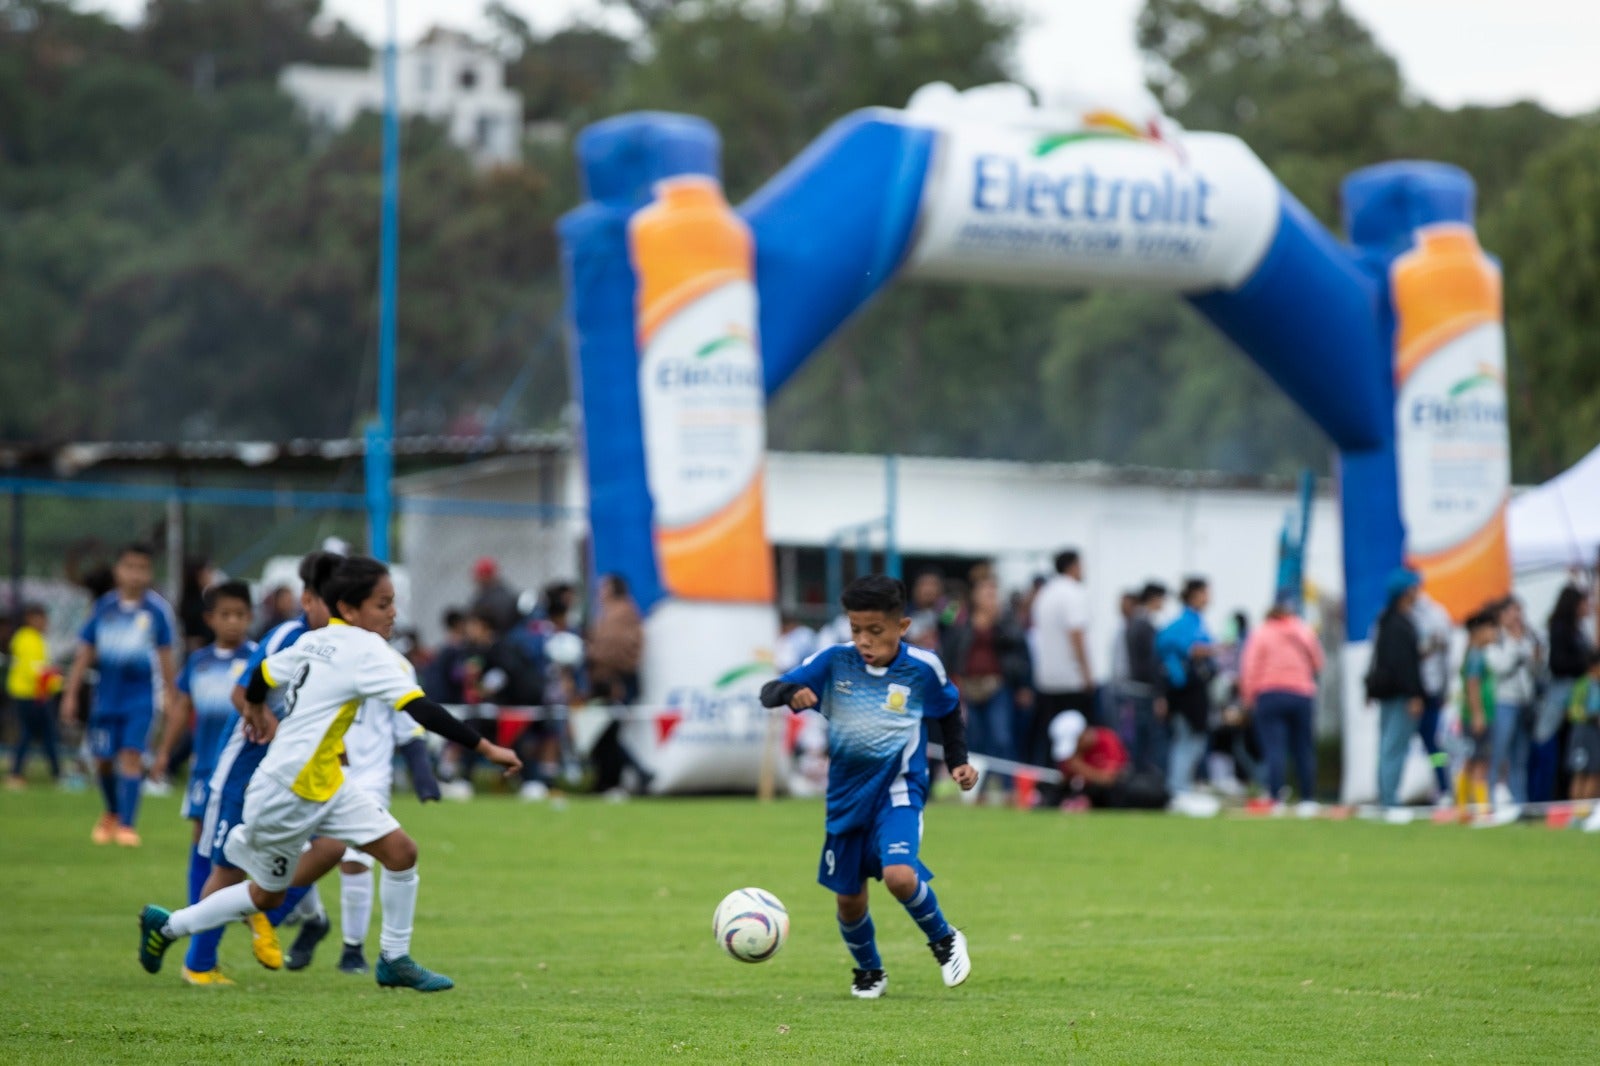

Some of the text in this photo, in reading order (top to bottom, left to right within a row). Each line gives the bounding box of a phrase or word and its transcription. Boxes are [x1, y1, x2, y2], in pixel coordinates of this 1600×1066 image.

[971, 153, 1216, 228] Electrolit
[271, 856, 288, 877] 3
[825, 849, 836, 876] 9
